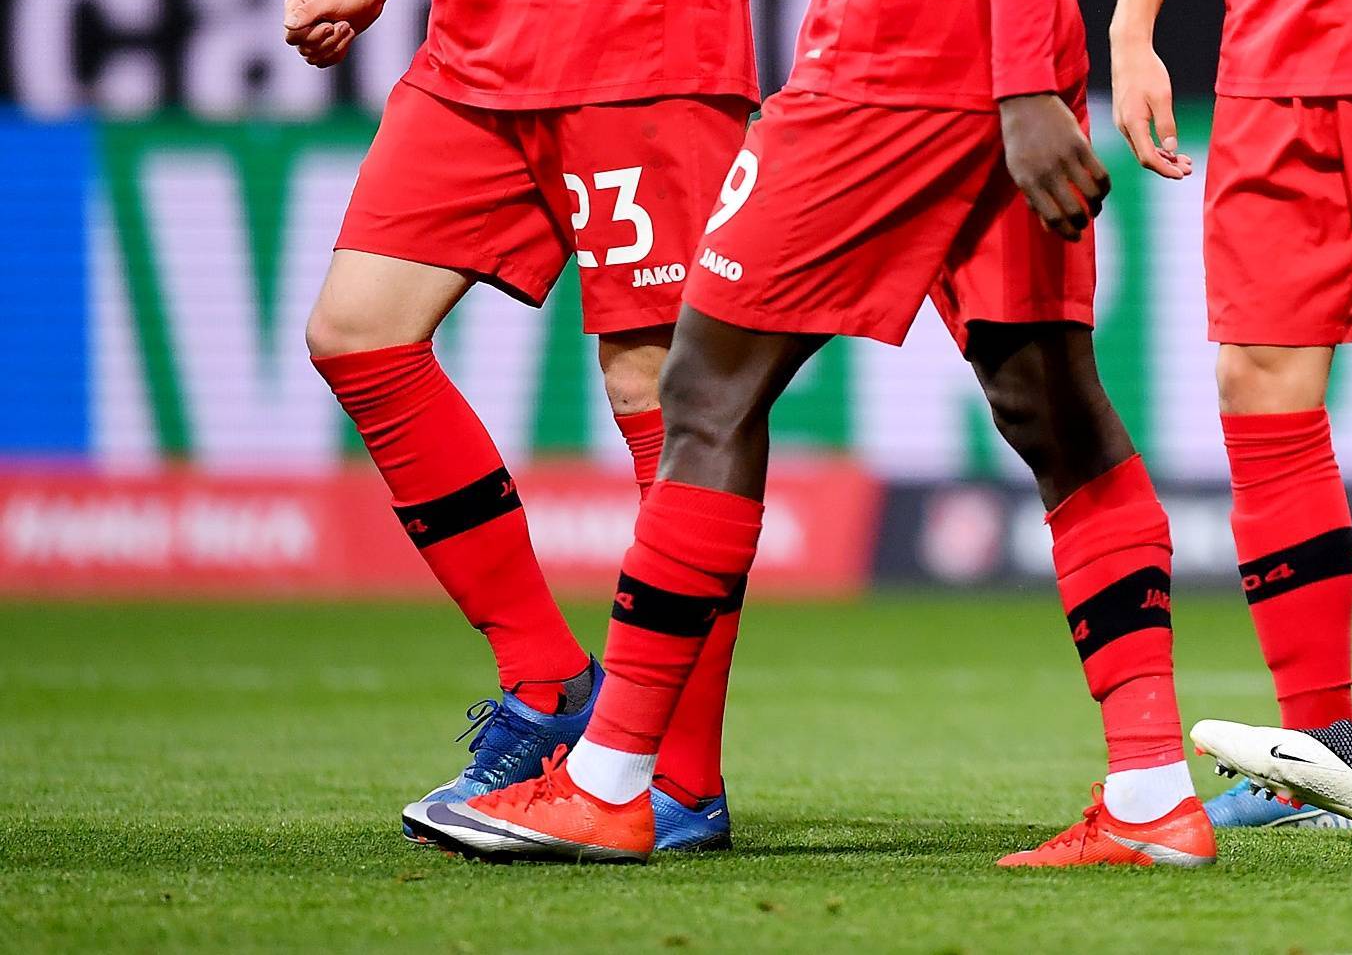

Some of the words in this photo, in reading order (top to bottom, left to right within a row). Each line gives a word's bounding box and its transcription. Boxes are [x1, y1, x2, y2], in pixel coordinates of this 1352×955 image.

[563, 166, 654, 268] 23
[632, 263, 686, 288] JAKO
[699, 248, 744, 282] JAKO
